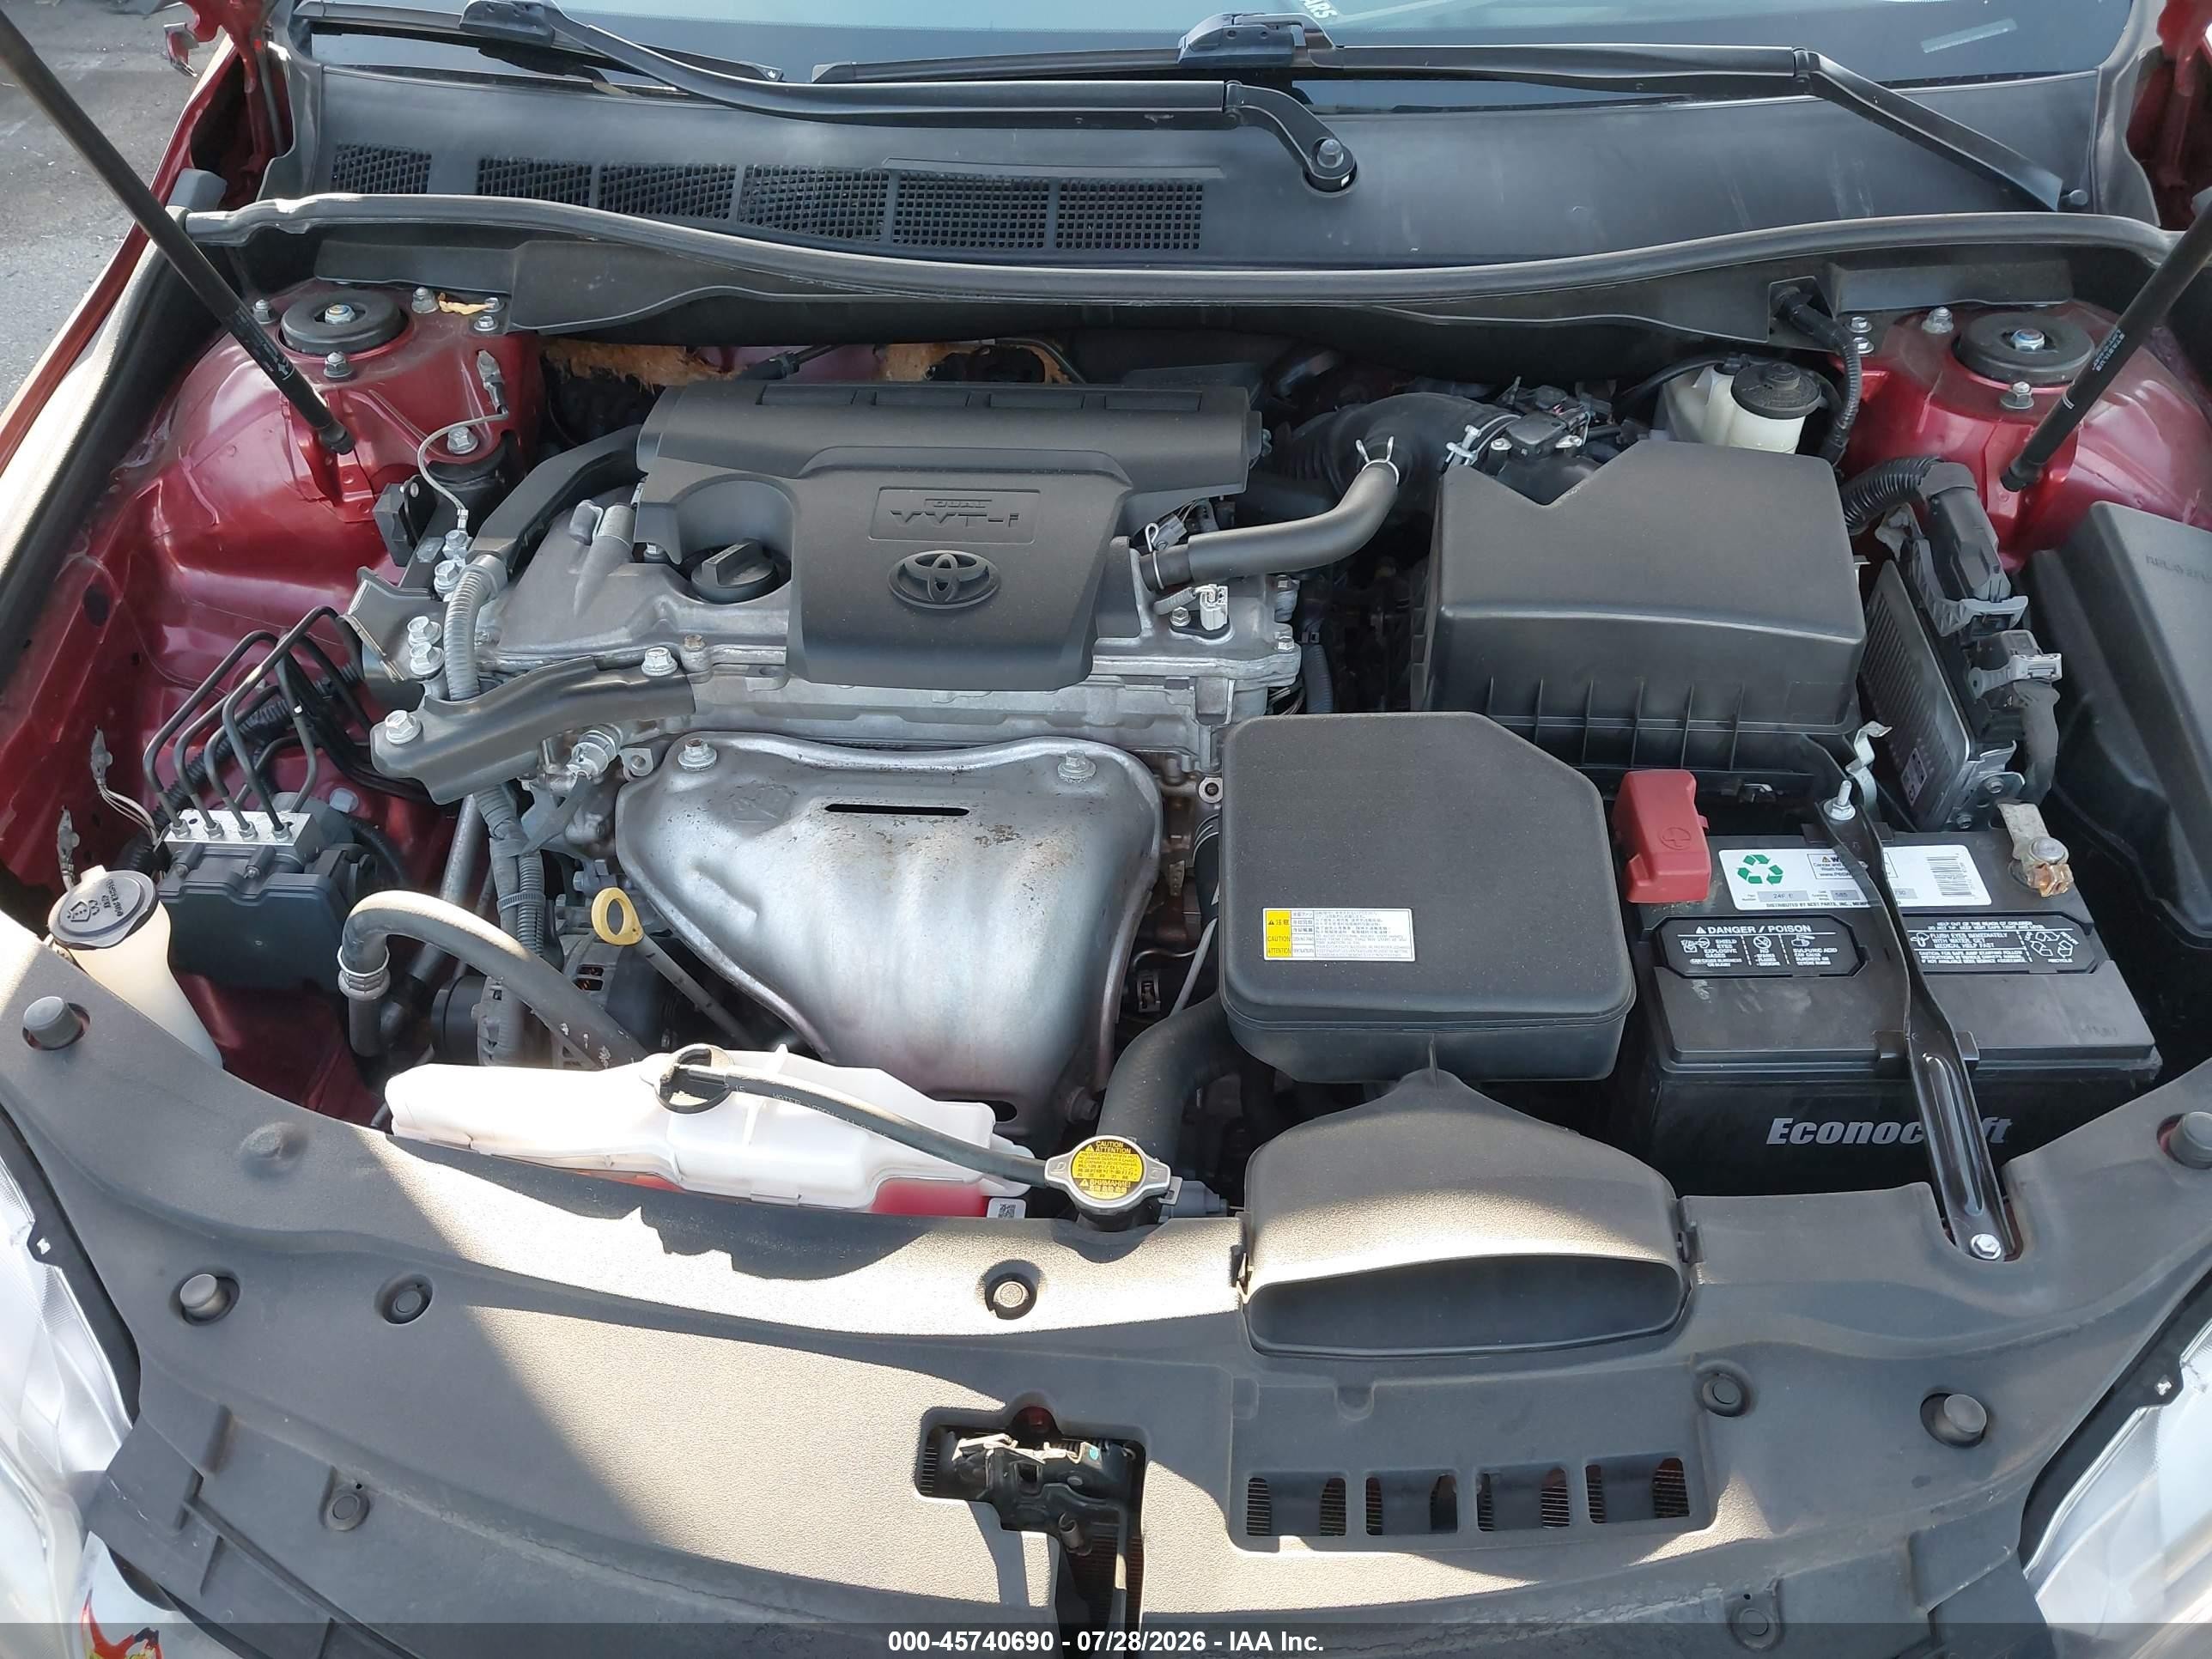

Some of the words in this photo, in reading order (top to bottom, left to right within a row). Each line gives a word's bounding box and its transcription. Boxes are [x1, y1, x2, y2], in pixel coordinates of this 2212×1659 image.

[1707, 926, 1757, 934] DANGER
[1767, 924, 1812, 933] POISON
[1766, 1116, 2013, 1145] Econocft
